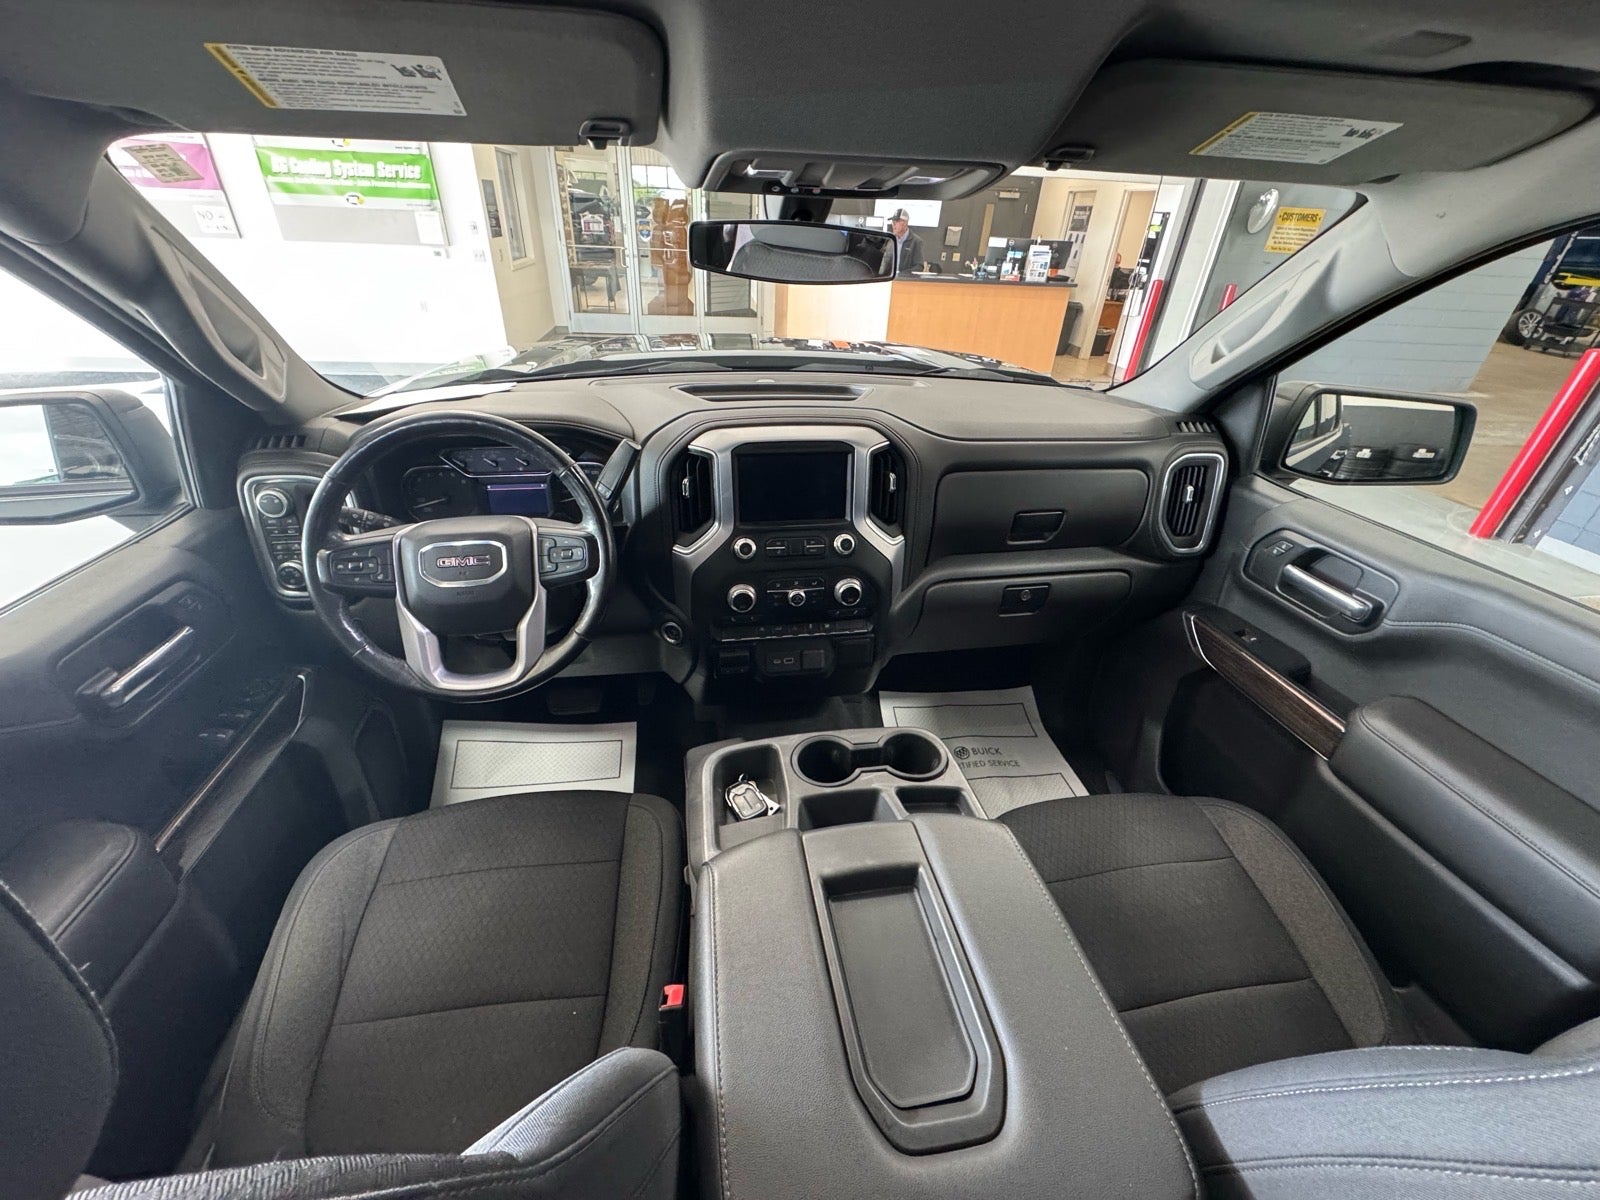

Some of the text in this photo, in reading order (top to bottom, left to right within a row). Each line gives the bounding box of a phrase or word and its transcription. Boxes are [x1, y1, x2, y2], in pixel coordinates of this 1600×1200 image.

[333, 159, 375, 180] System
[376, 160, 421, 180] Service
[436, 555, 490, 568] GMC
[971, 747, 1002, 756] BUICK
[988, 759, 1020, 767] SERVICE
